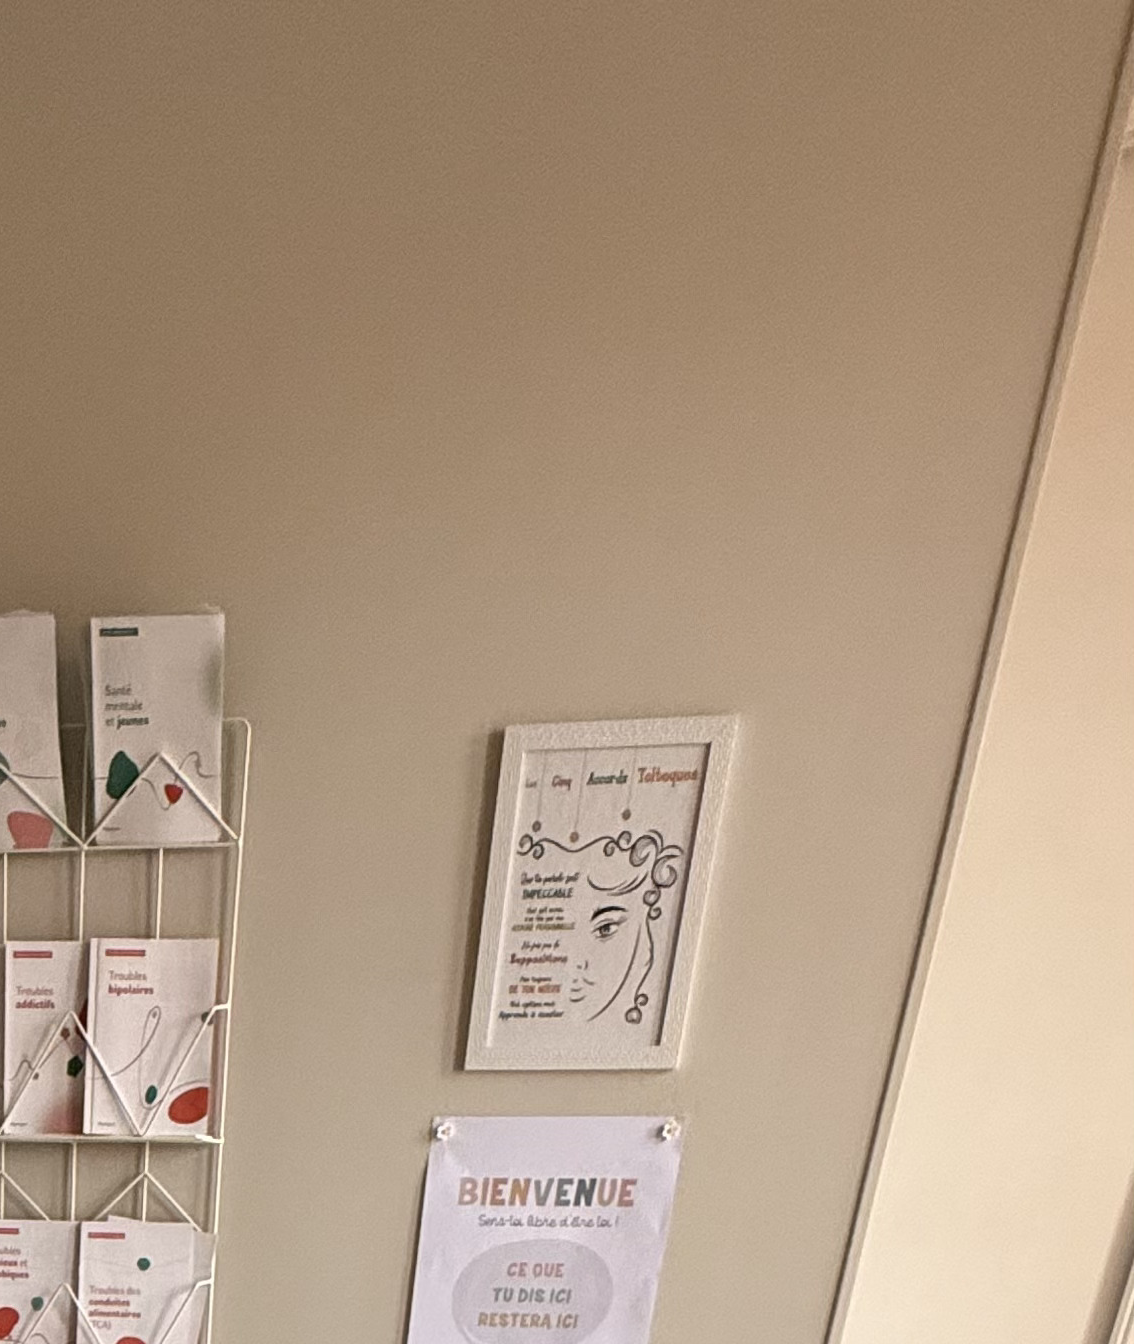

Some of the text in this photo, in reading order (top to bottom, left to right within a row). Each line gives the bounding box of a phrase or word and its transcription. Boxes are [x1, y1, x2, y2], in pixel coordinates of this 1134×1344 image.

[116, 714, 149, 730] jeunes
[586, 769, 629, 786] Accords
[109, 969, 148, 981] Troubles
[16, 985, 54, 996] Troubles
[108, 983, 154, 996] bipolaires
[15, 998, 56, 1010] addictifs
[456, 1176, 638, 1208] BIENVENUE
[506, 1261, 565, 1279] CE QUE
[492, 1287, 572, 1304] TU DIS ICI
[477, 1311, 580, 1329] RESTERA ICI
